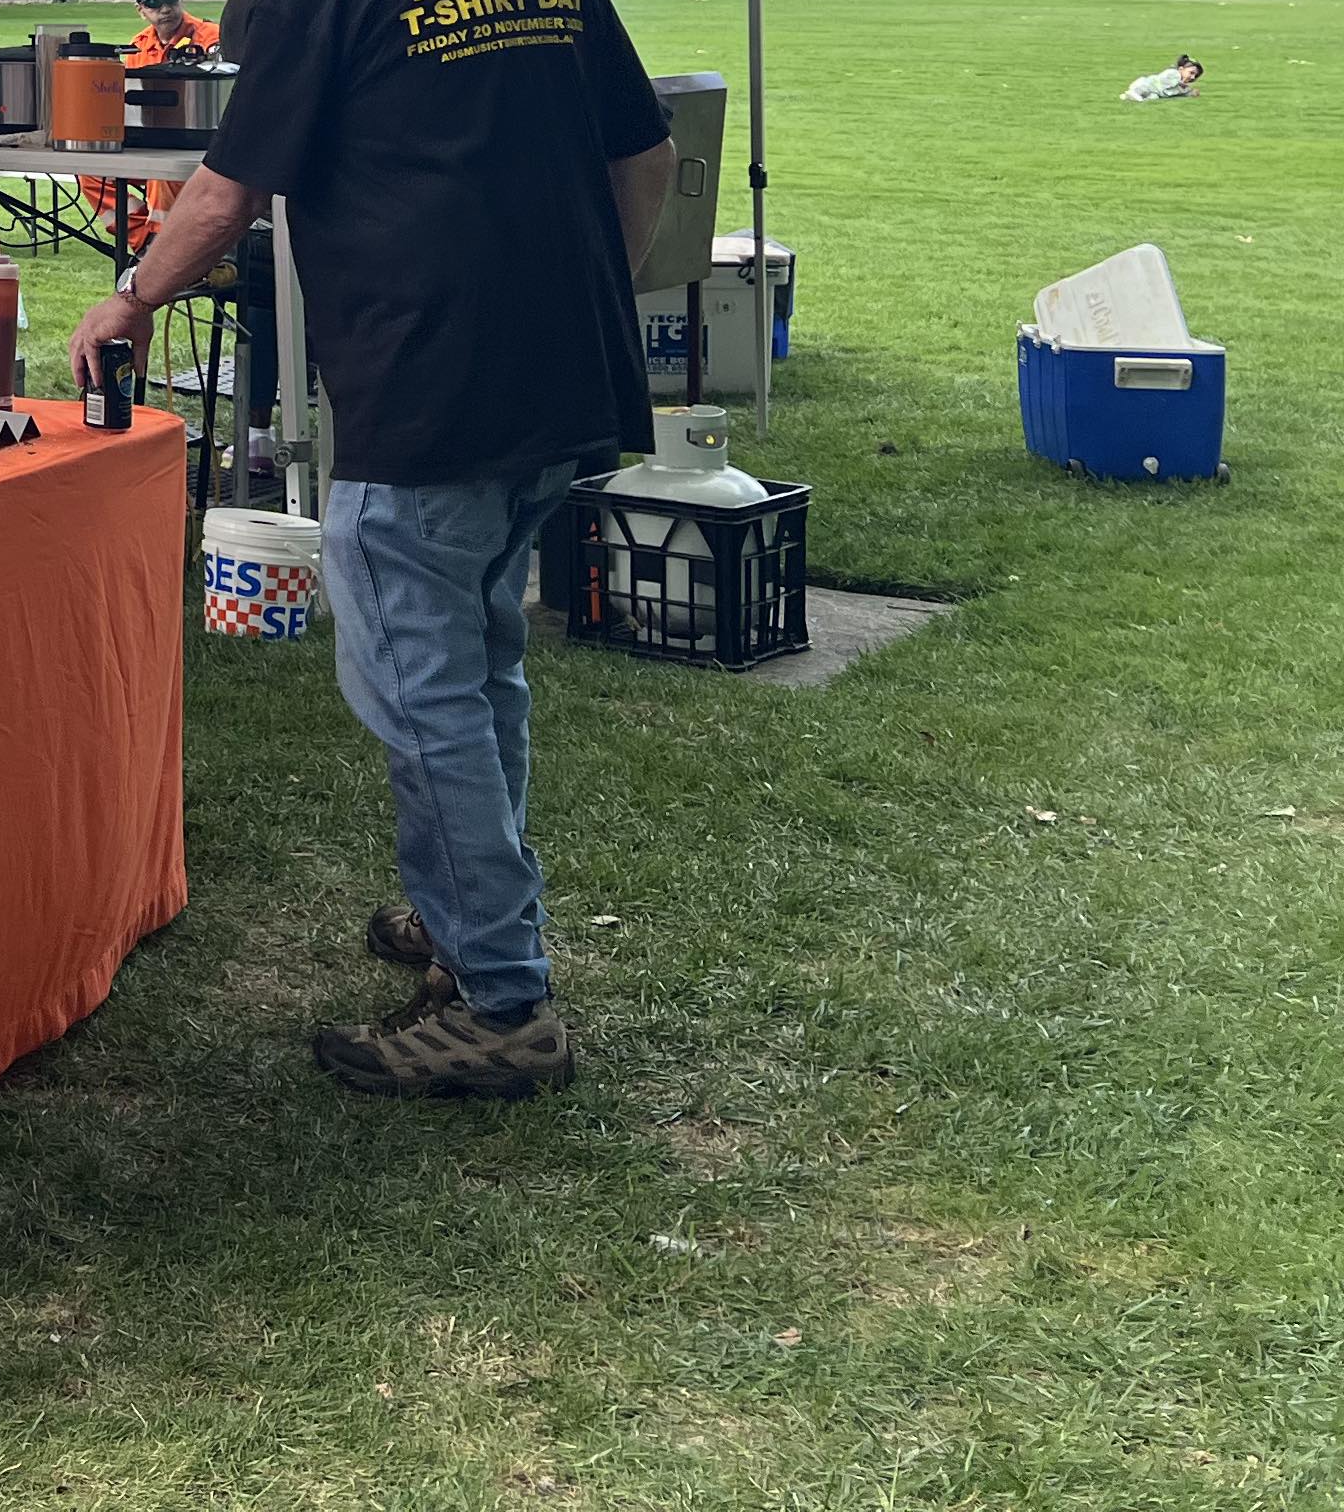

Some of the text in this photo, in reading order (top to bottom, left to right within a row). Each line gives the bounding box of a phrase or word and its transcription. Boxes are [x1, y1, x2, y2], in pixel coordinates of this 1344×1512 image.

[406, 29, 469, 57] FRIDAY
[473, 23, 492, 39] 20
[495, 17, 566, 34] NOVEMBER
[204, 553, 262, 598] SES
